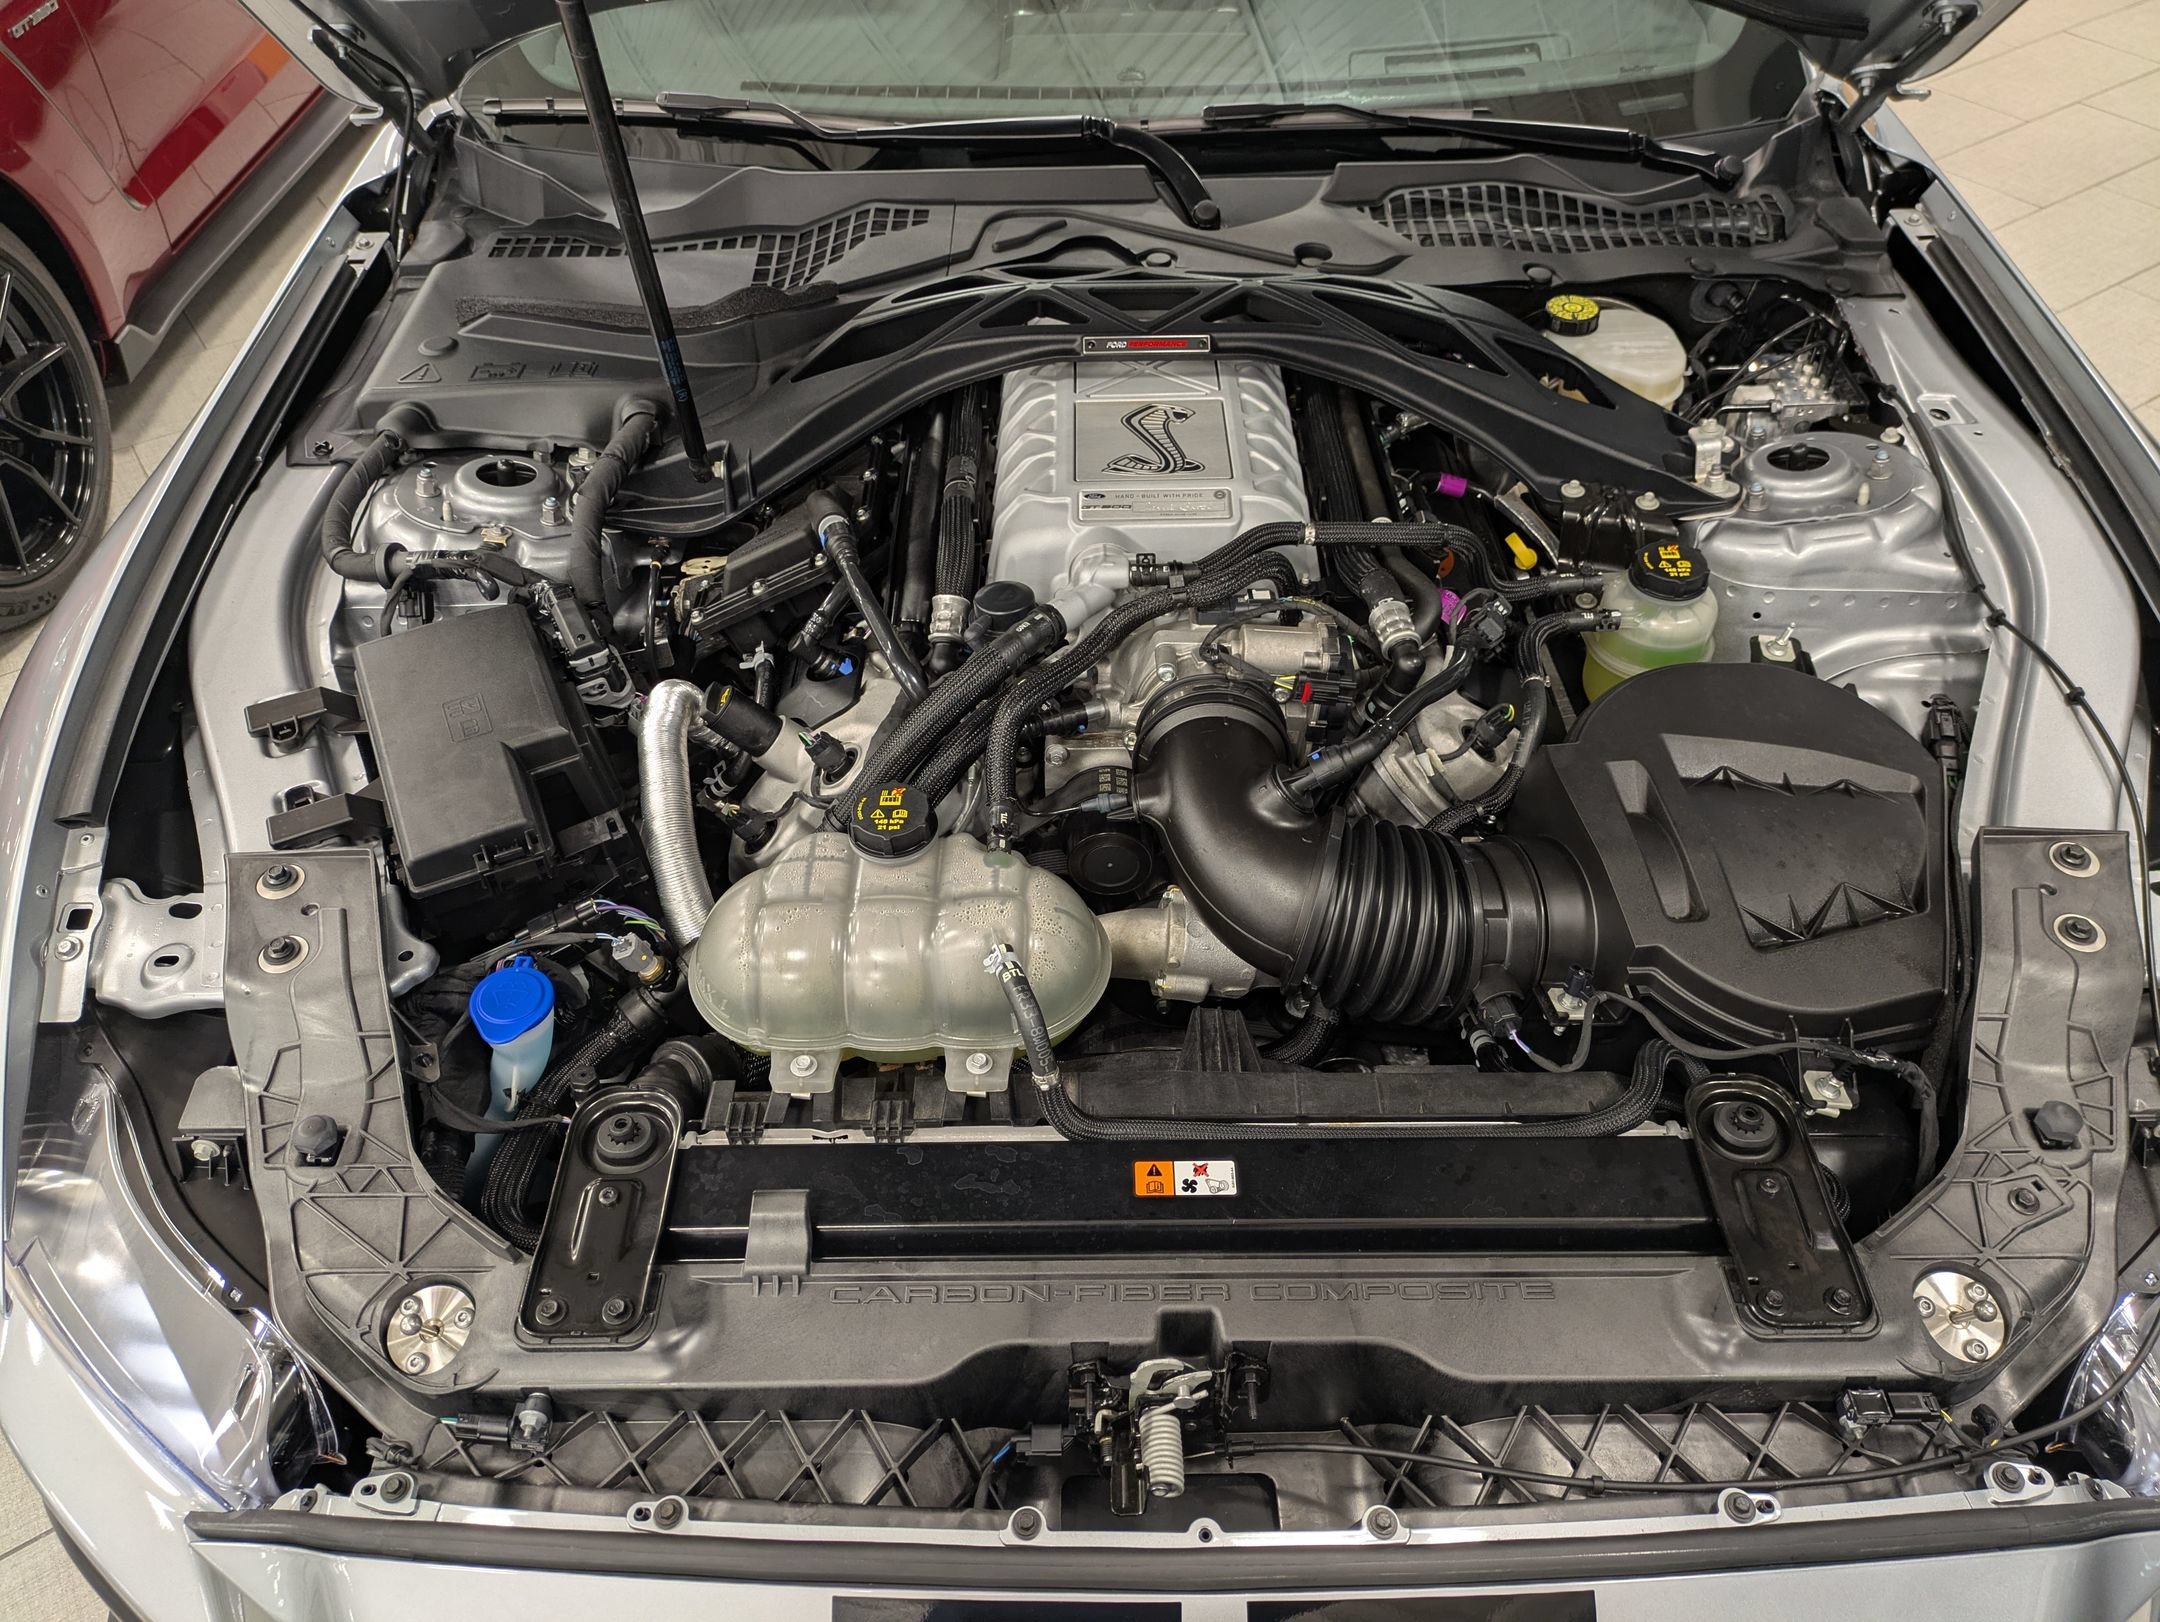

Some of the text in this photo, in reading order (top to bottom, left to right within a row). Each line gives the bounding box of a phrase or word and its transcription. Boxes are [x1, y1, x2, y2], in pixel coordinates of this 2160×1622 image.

[1106, 341, 1127, 349] FORD
[1002, 968, 1024, 983] BTL
[829, 1281, 1555, 1305] CARBON-FIBER COMPOSITE
